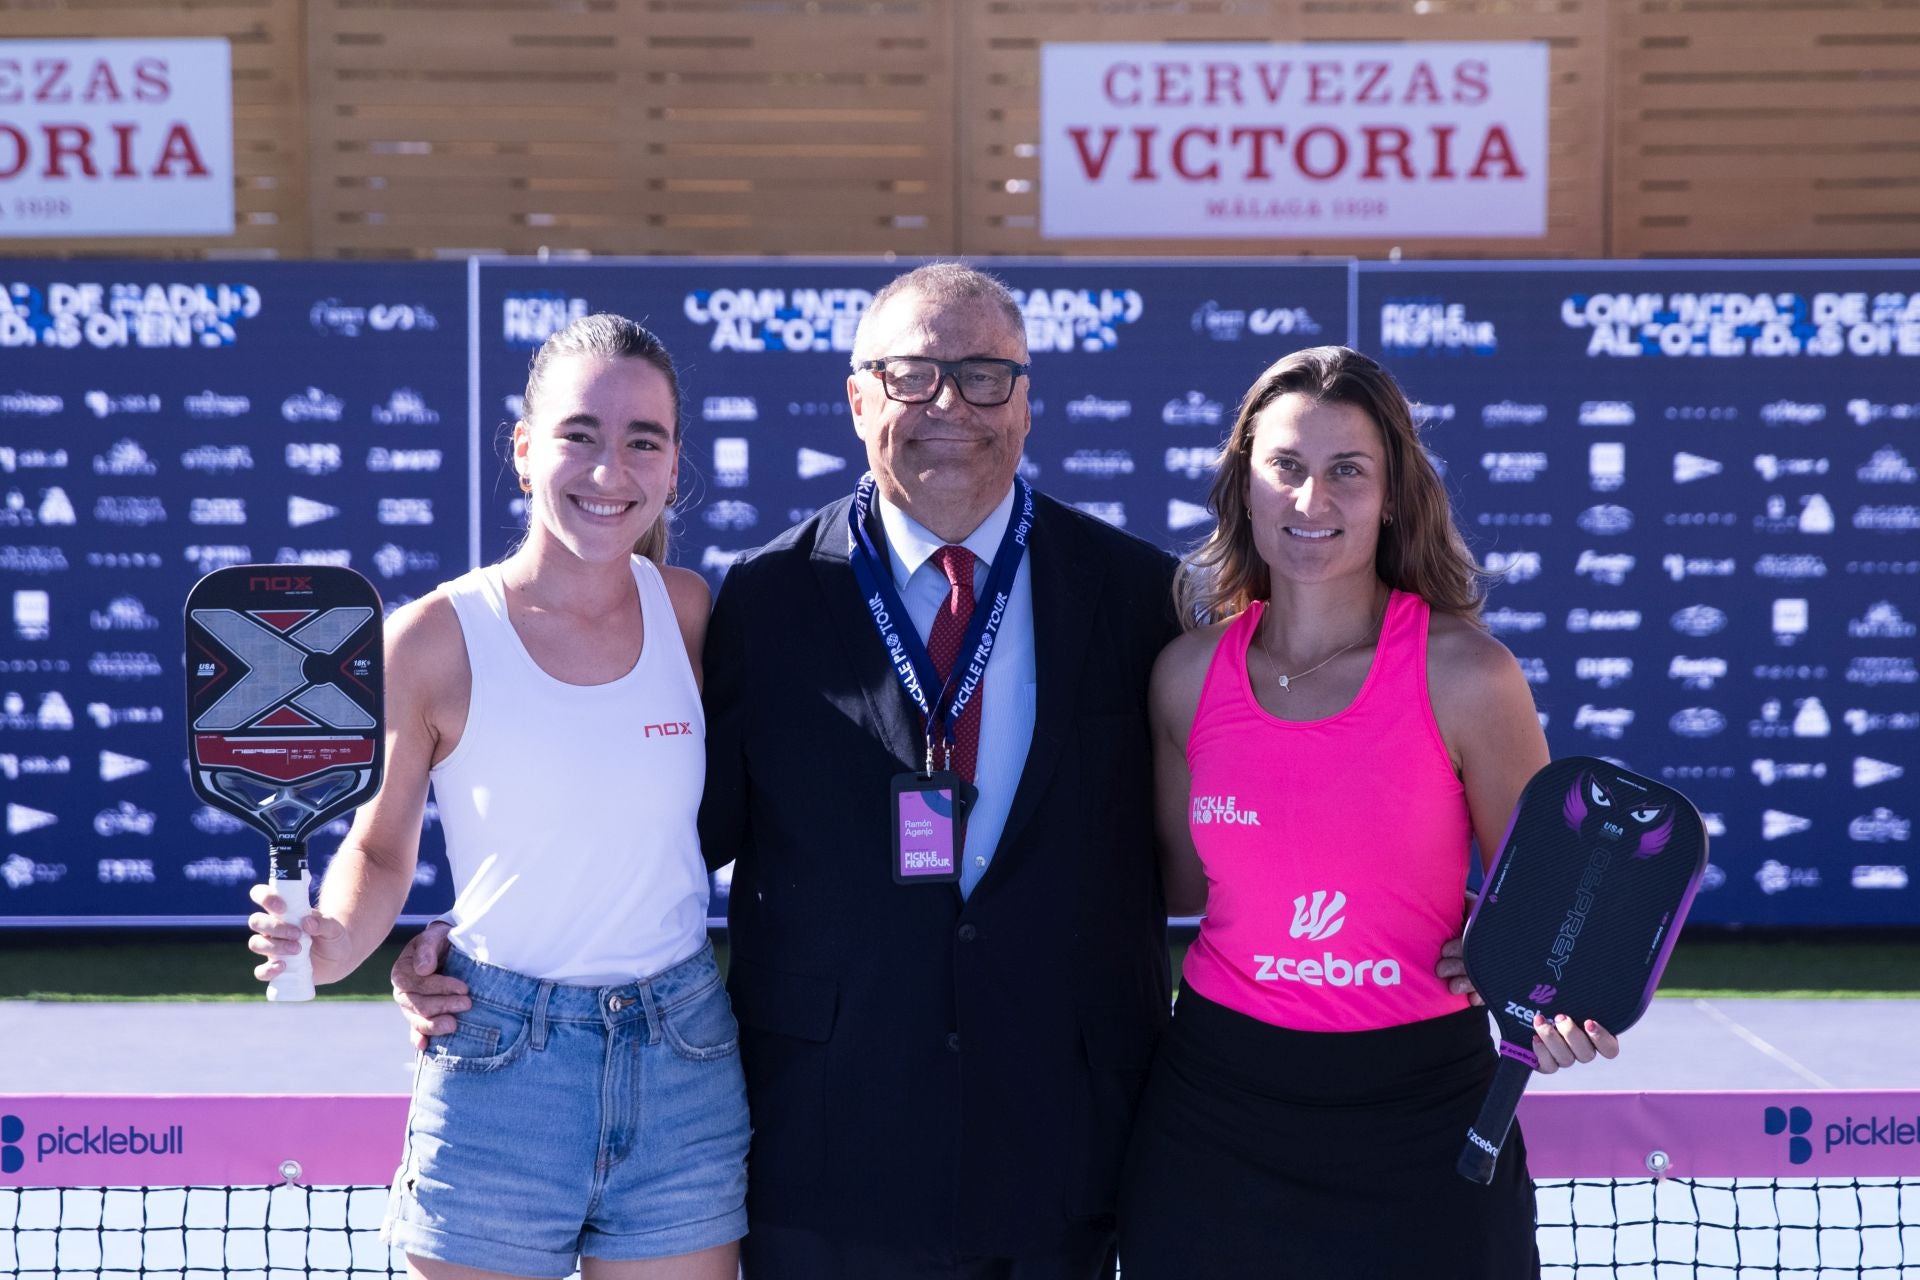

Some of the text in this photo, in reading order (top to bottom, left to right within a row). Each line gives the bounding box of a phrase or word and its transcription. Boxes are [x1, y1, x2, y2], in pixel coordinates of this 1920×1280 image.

[0, 58, 172, 104] EZAS
[1103, 61, 1491, 107] CERVEZAS
[0, 123, 212, 180] ORIA
[1066, 126, 1527, 182] VICTORIA
[1014, 517, 1032, 546] play
[868, 591, 893, 636] TOUR
[951, 662, 983, 718] PICKLE
[986, 591, 1008, 632] TOUR
[904, 820, 932, 828] Ramón
[904, 828, 934, 838] Agenjo
[1603, 821, 1624, 836] USA
[904, 851, 938, 861] PICKLE
[1253, 952, 1401, 987] zcebra
[37, 1125, 183, 1163] picklebull
[1825, 1116, 1920, 1154] pickle
